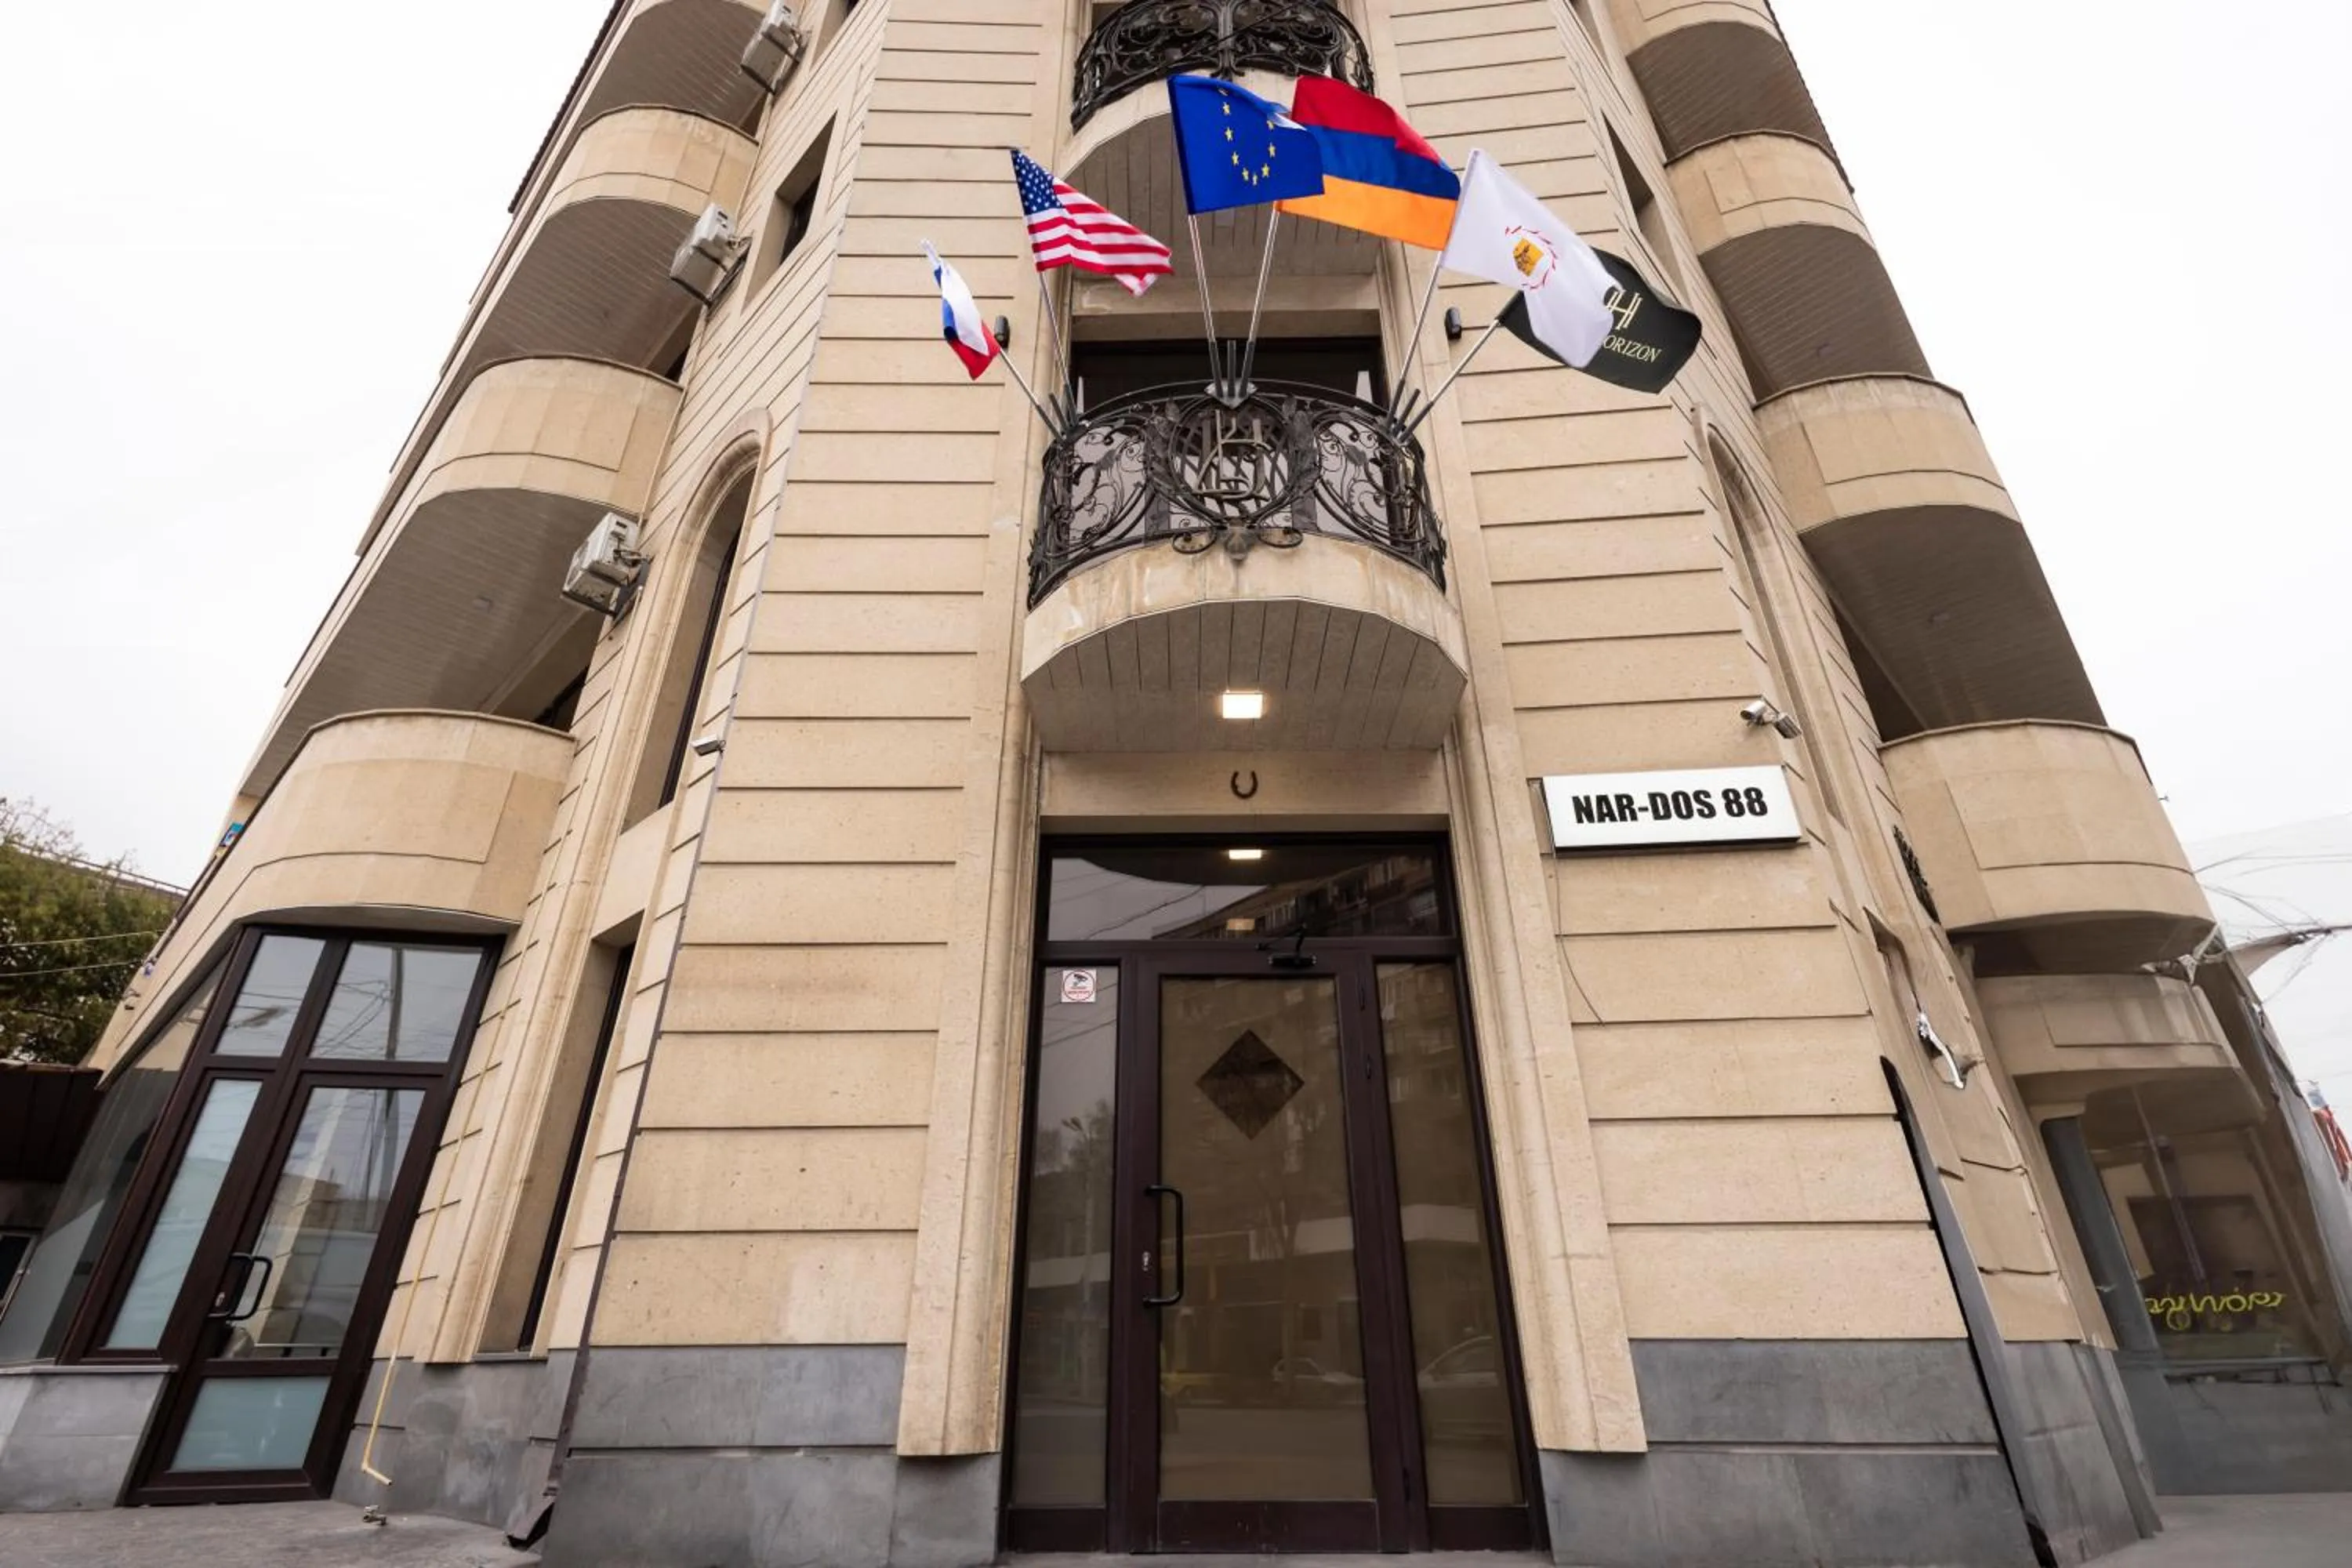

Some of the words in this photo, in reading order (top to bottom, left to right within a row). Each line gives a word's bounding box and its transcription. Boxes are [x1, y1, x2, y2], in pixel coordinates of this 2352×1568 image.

[1602, 335, 1662, 363] ORIZON
[1572, 789, 1717, 824] NAR-DOS
[1722, 787, 1769, 818] 88
